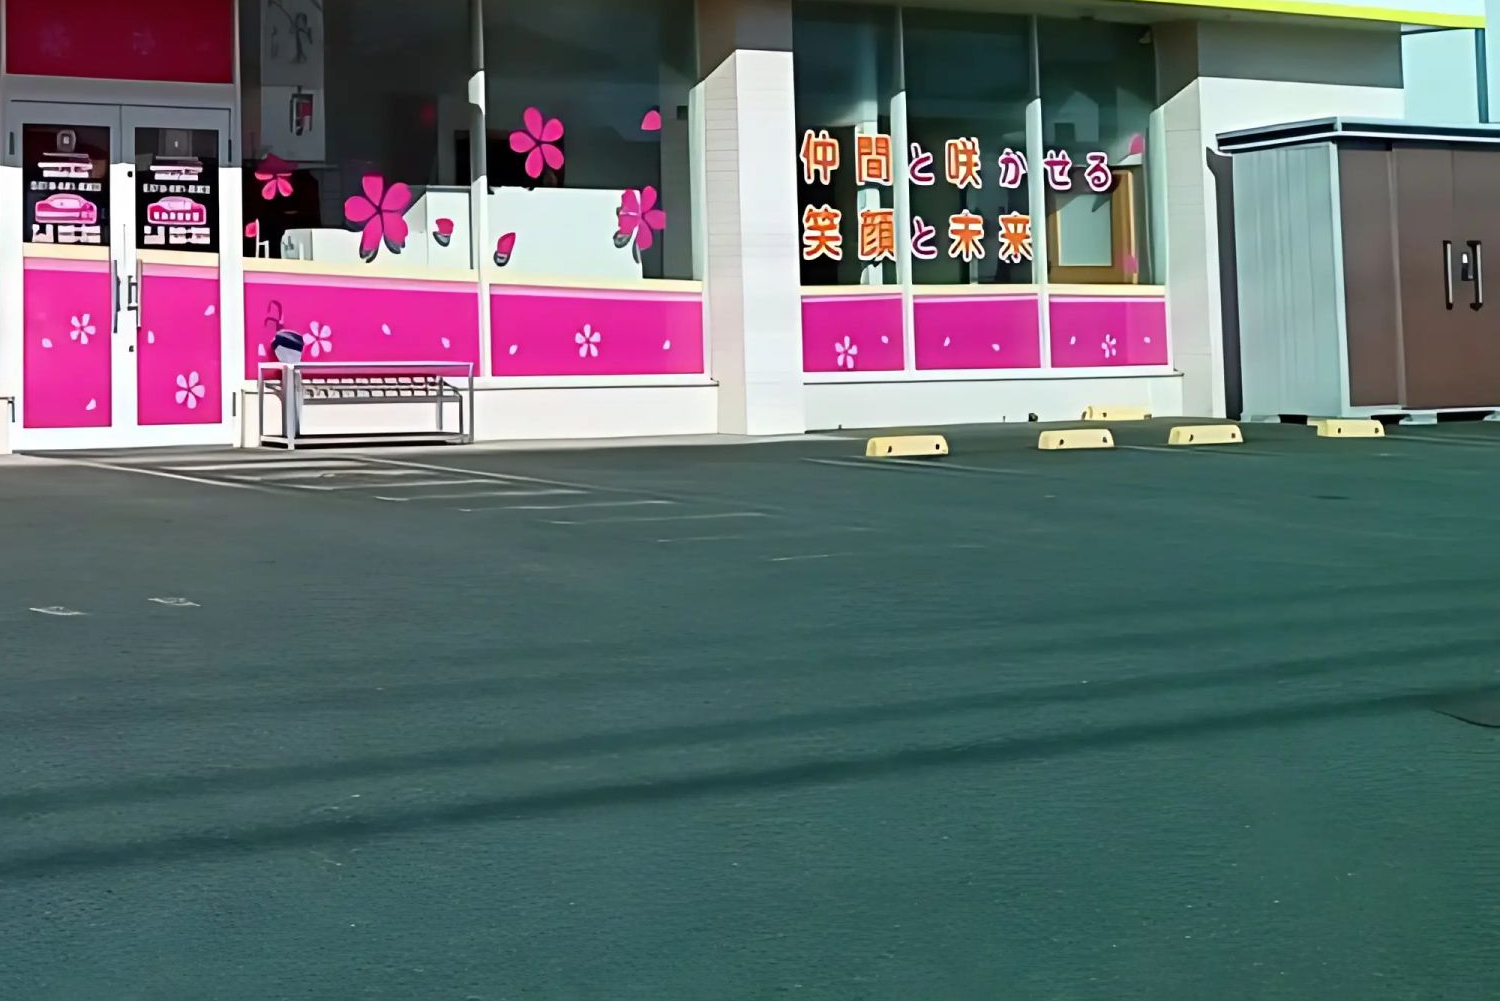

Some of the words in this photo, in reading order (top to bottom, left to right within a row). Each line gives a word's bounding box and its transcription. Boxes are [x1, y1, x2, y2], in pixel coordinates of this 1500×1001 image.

[799, 128, 1113, 192] 仲間と咲かせる
[802, 203, 1034, 264] 笑顔と未来
